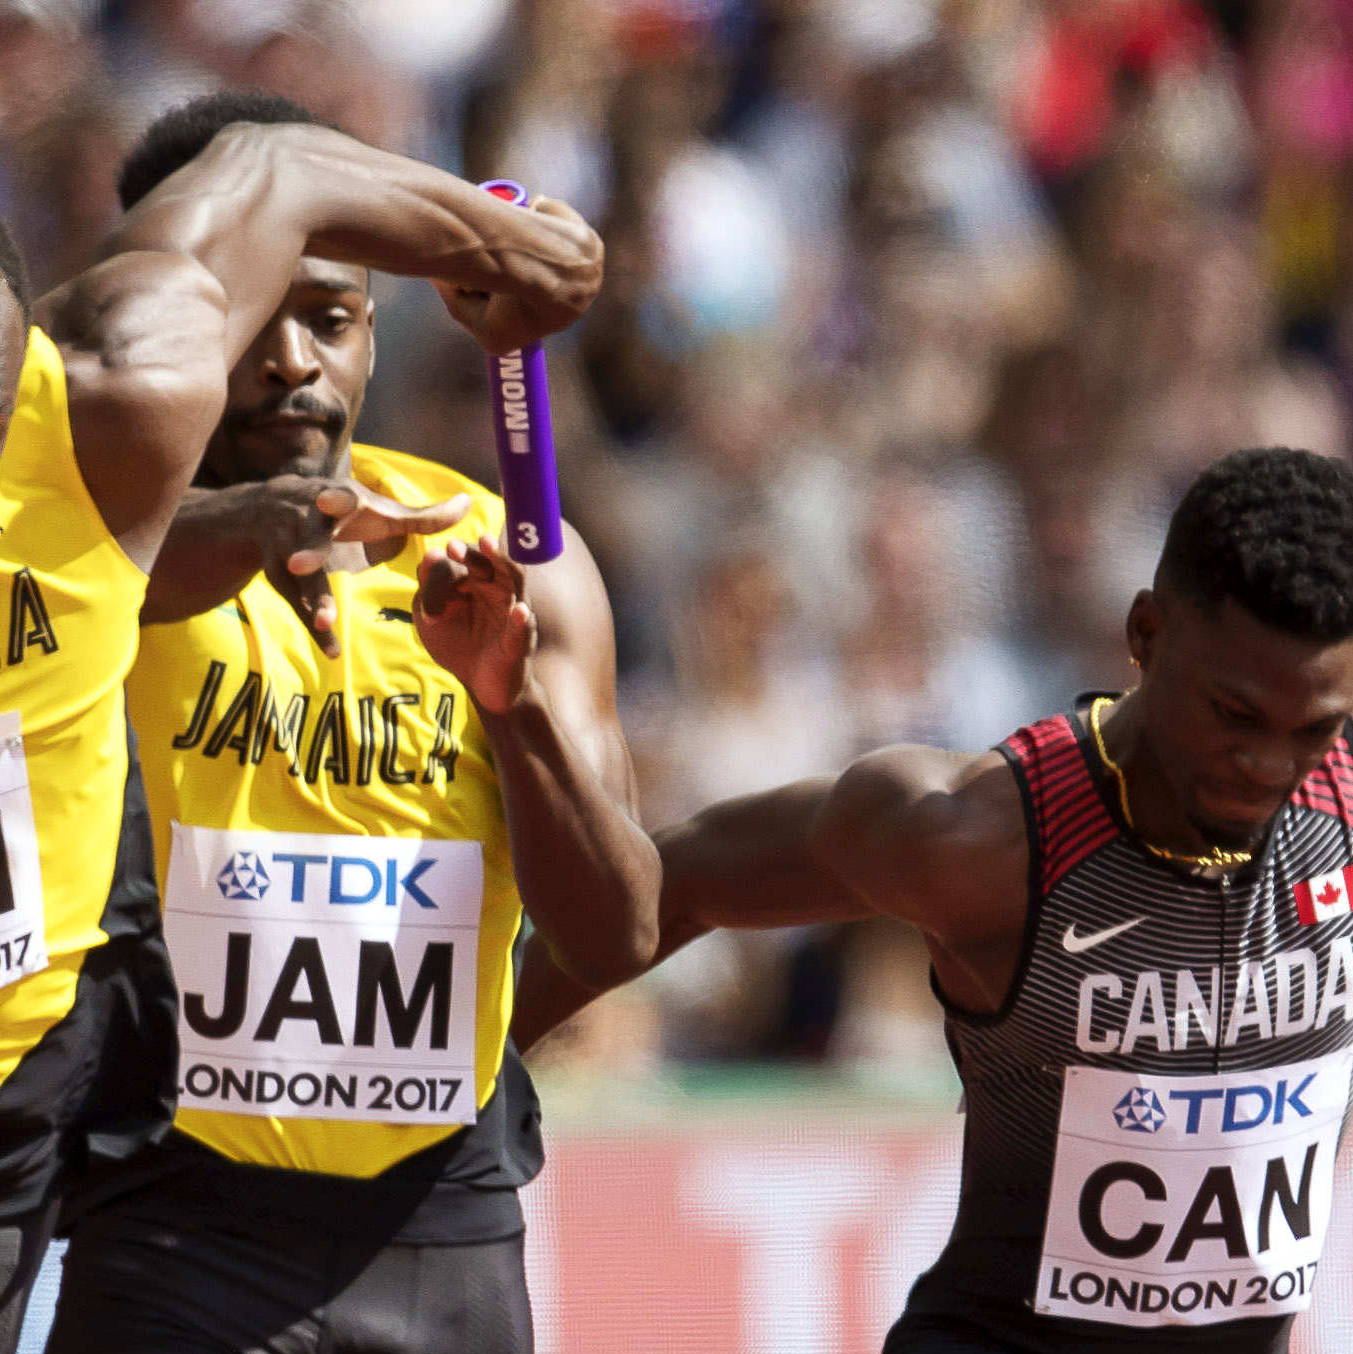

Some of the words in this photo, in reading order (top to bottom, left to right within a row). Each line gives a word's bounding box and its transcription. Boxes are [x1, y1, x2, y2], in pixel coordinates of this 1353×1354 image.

[498, 347, 531, 432] MON
[517, 522, 540, 551] 3
[172, 661, 463, 786] JAMAICA
[273, 853, 440, 909] TDK
[184, 932, 454, 1050] JAM
[367, 1075, 462, 1113] 2017
[1169, 1073, 1320, 1134] TDK
[1078, 1142, 1319, 1263] CAN
[1049, 1267, 1238, 1314] LONDON
[1243, 1260, 1319, 1305] 2017
